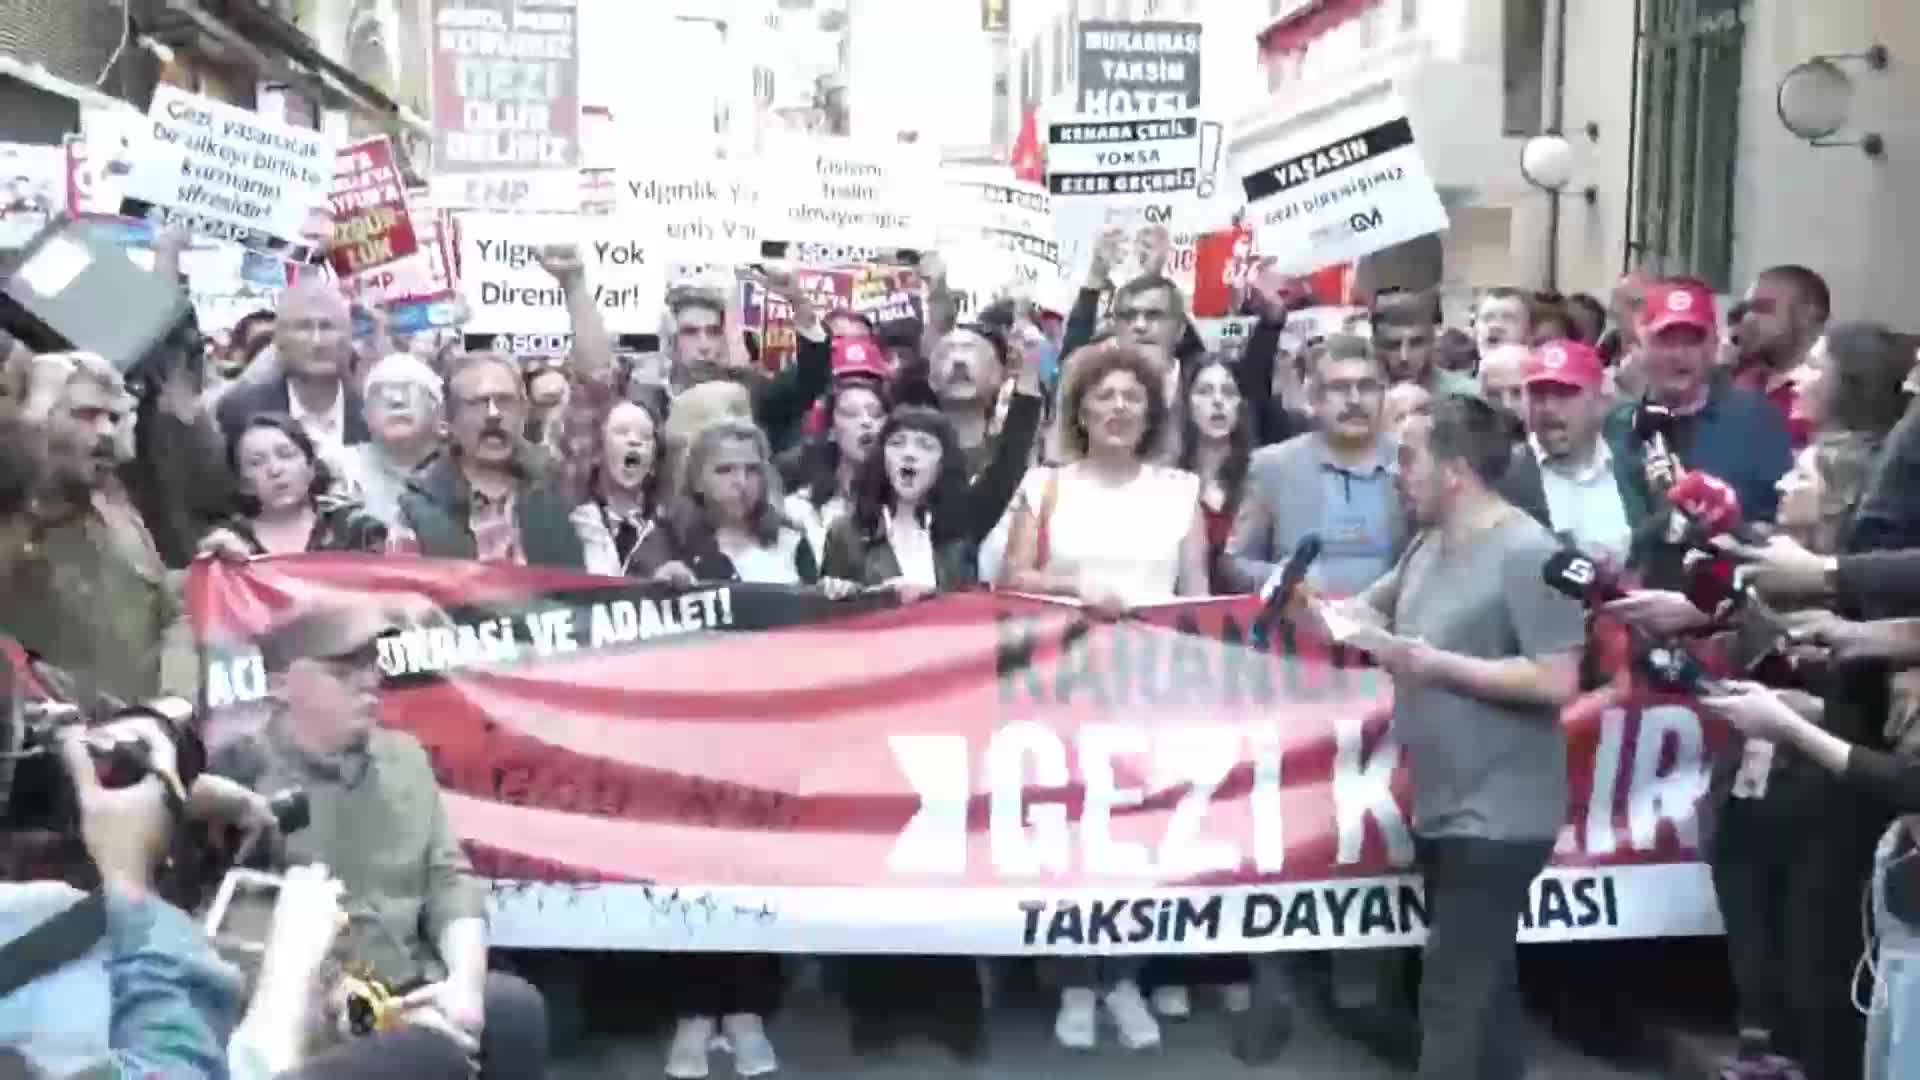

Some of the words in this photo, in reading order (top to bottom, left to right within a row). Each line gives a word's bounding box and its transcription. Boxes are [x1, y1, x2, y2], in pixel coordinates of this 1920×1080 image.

[1096, 149, 1160, 166] YOKSA
[1272, 138, 1369, 187] YAŞASIN
[594, 239, 645, 264] Yok
[526, 609, 577, 657] VE
[591, 587, 733, 649] ADALET!
